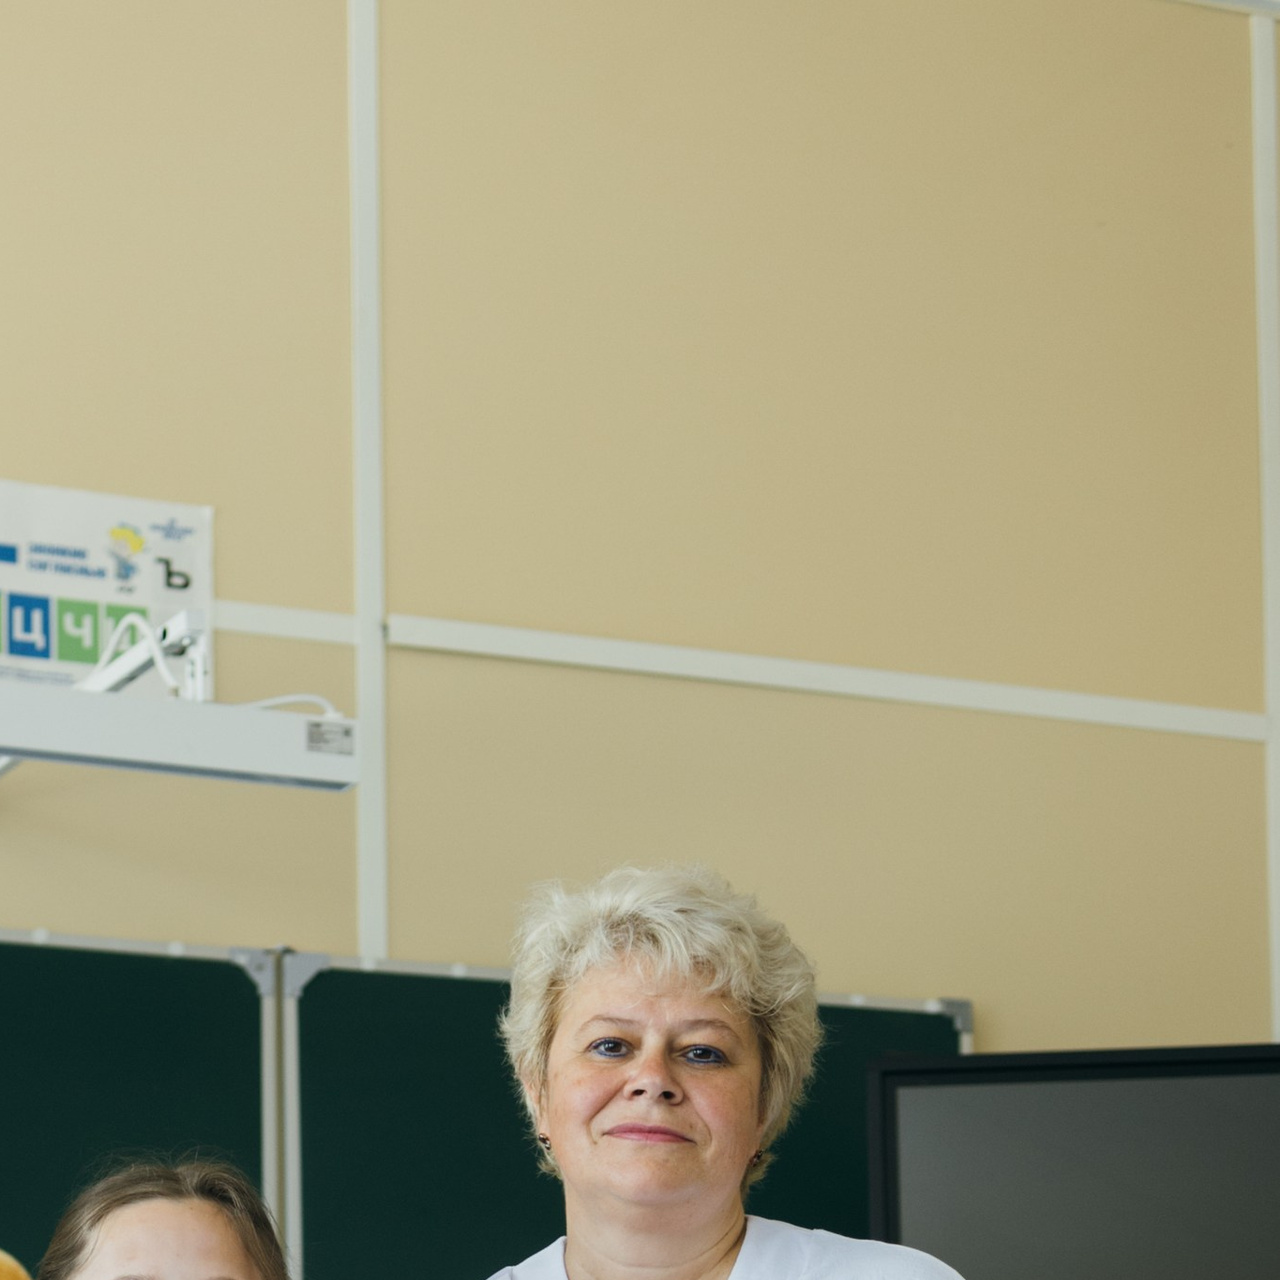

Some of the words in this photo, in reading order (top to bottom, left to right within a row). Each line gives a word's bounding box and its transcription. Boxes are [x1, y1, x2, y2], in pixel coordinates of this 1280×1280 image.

[155, 556, 191, 590] Ъ
[12, 606, 46, 651] Ц
[63, 611, 93, 649] Ч
